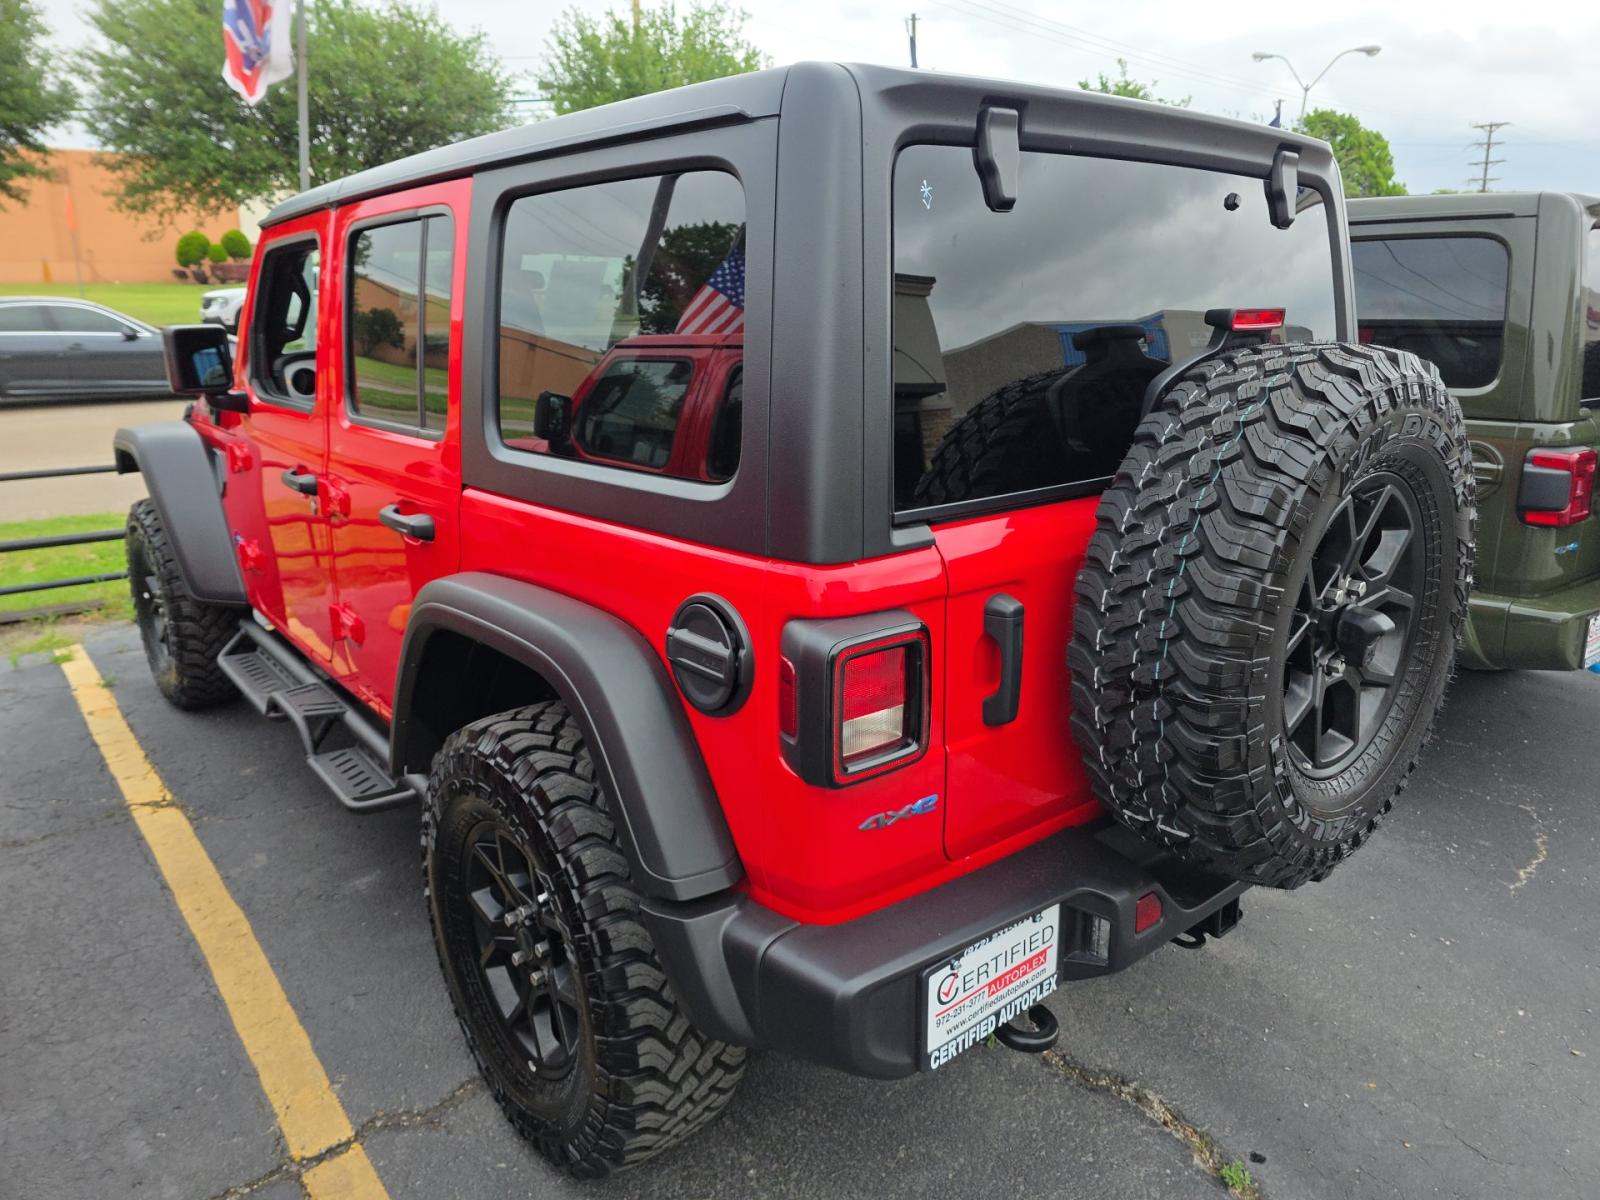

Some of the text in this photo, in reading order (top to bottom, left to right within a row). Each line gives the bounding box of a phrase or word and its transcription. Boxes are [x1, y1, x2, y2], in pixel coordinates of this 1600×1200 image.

[937, 924, 1054, 1005] CERTIFIED
[988, 953, 1047, 996] AUTOPLEX
[930, 974, 1058, 1070] CERTIFIED AUTOPLEX
[935, 990, 986, 1028] 972-231-3777
[946, 968, 1047, 1036] www.certifiedautoplex.com
